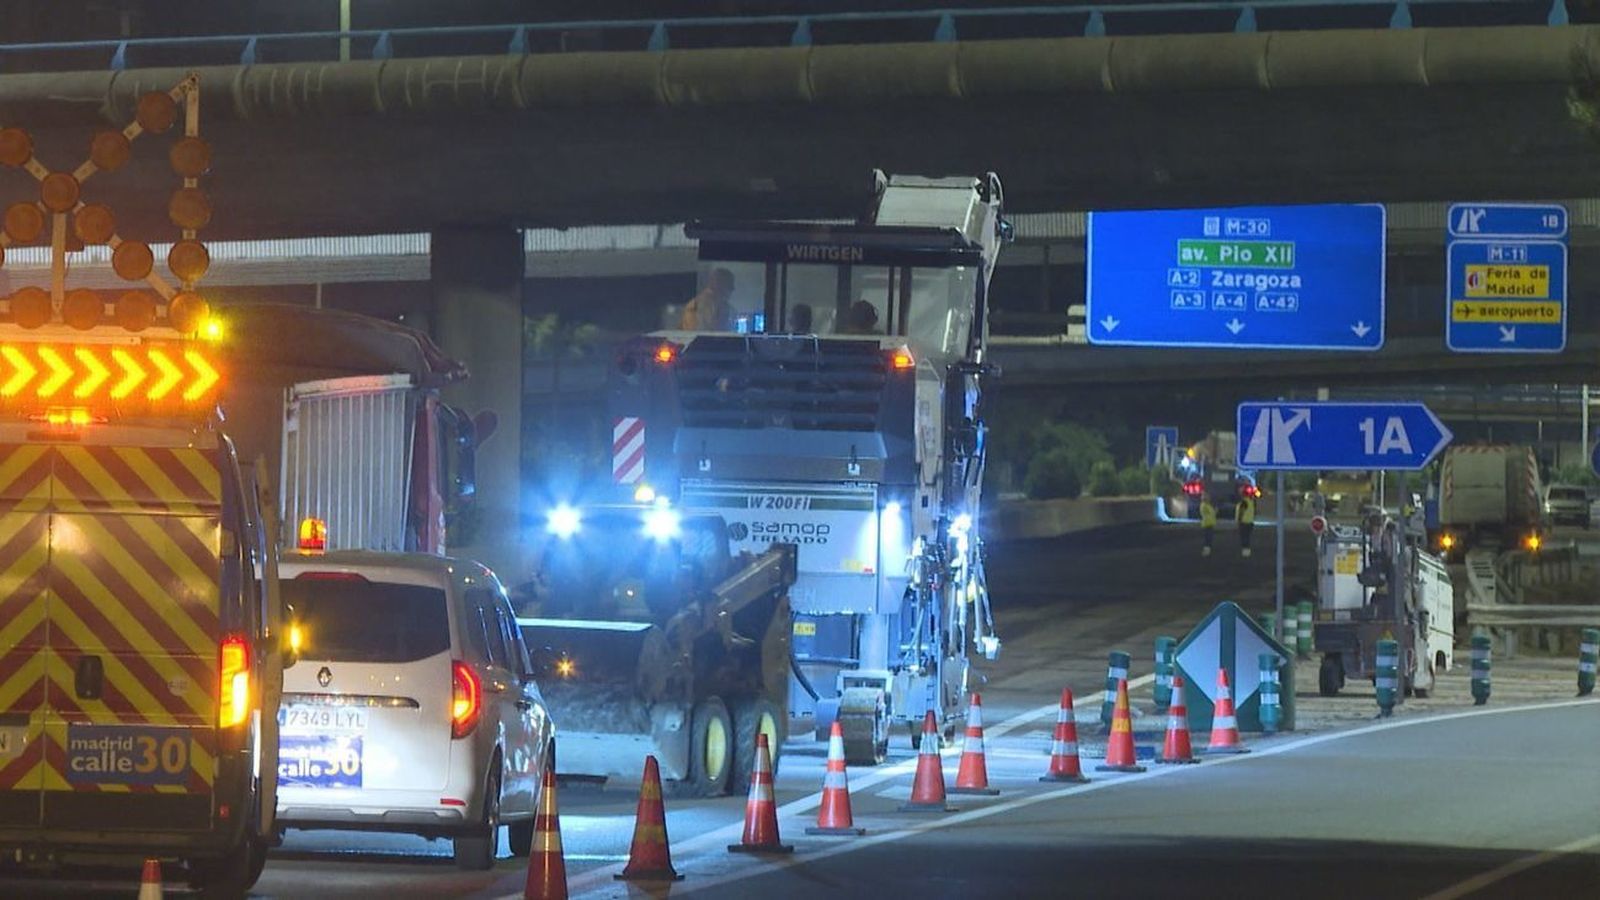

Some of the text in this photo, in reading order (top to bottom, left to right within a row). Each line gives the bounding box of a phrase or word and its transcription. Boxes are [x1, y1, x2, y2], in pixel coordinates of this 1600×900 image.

[1227, 219, 1267, 234] M-30
[787, 245, 863, 261] WIRTGEN
[1181, 247, 1208, 261] av.
[1265, 246, 1292, 263] XII
[1491, 247, 1525, 261] M-11
[1172, 270, 1301, 291] A-2 Zaragoza
[1486, 268, 1546, 279] Feria de
[1486, 285, 1535, 295] Madrid
[1174, 294, 1296, 308] A-3 A-4 A-42
[1479, 306, 1554, 318] aeropuerto
[1359, 416, 1413, 455] 1A
[289, 711, 365, 728] 7349 LYL
[71, 735, 187, 774] madrid 30
[71, 752, 133, 773] calle
